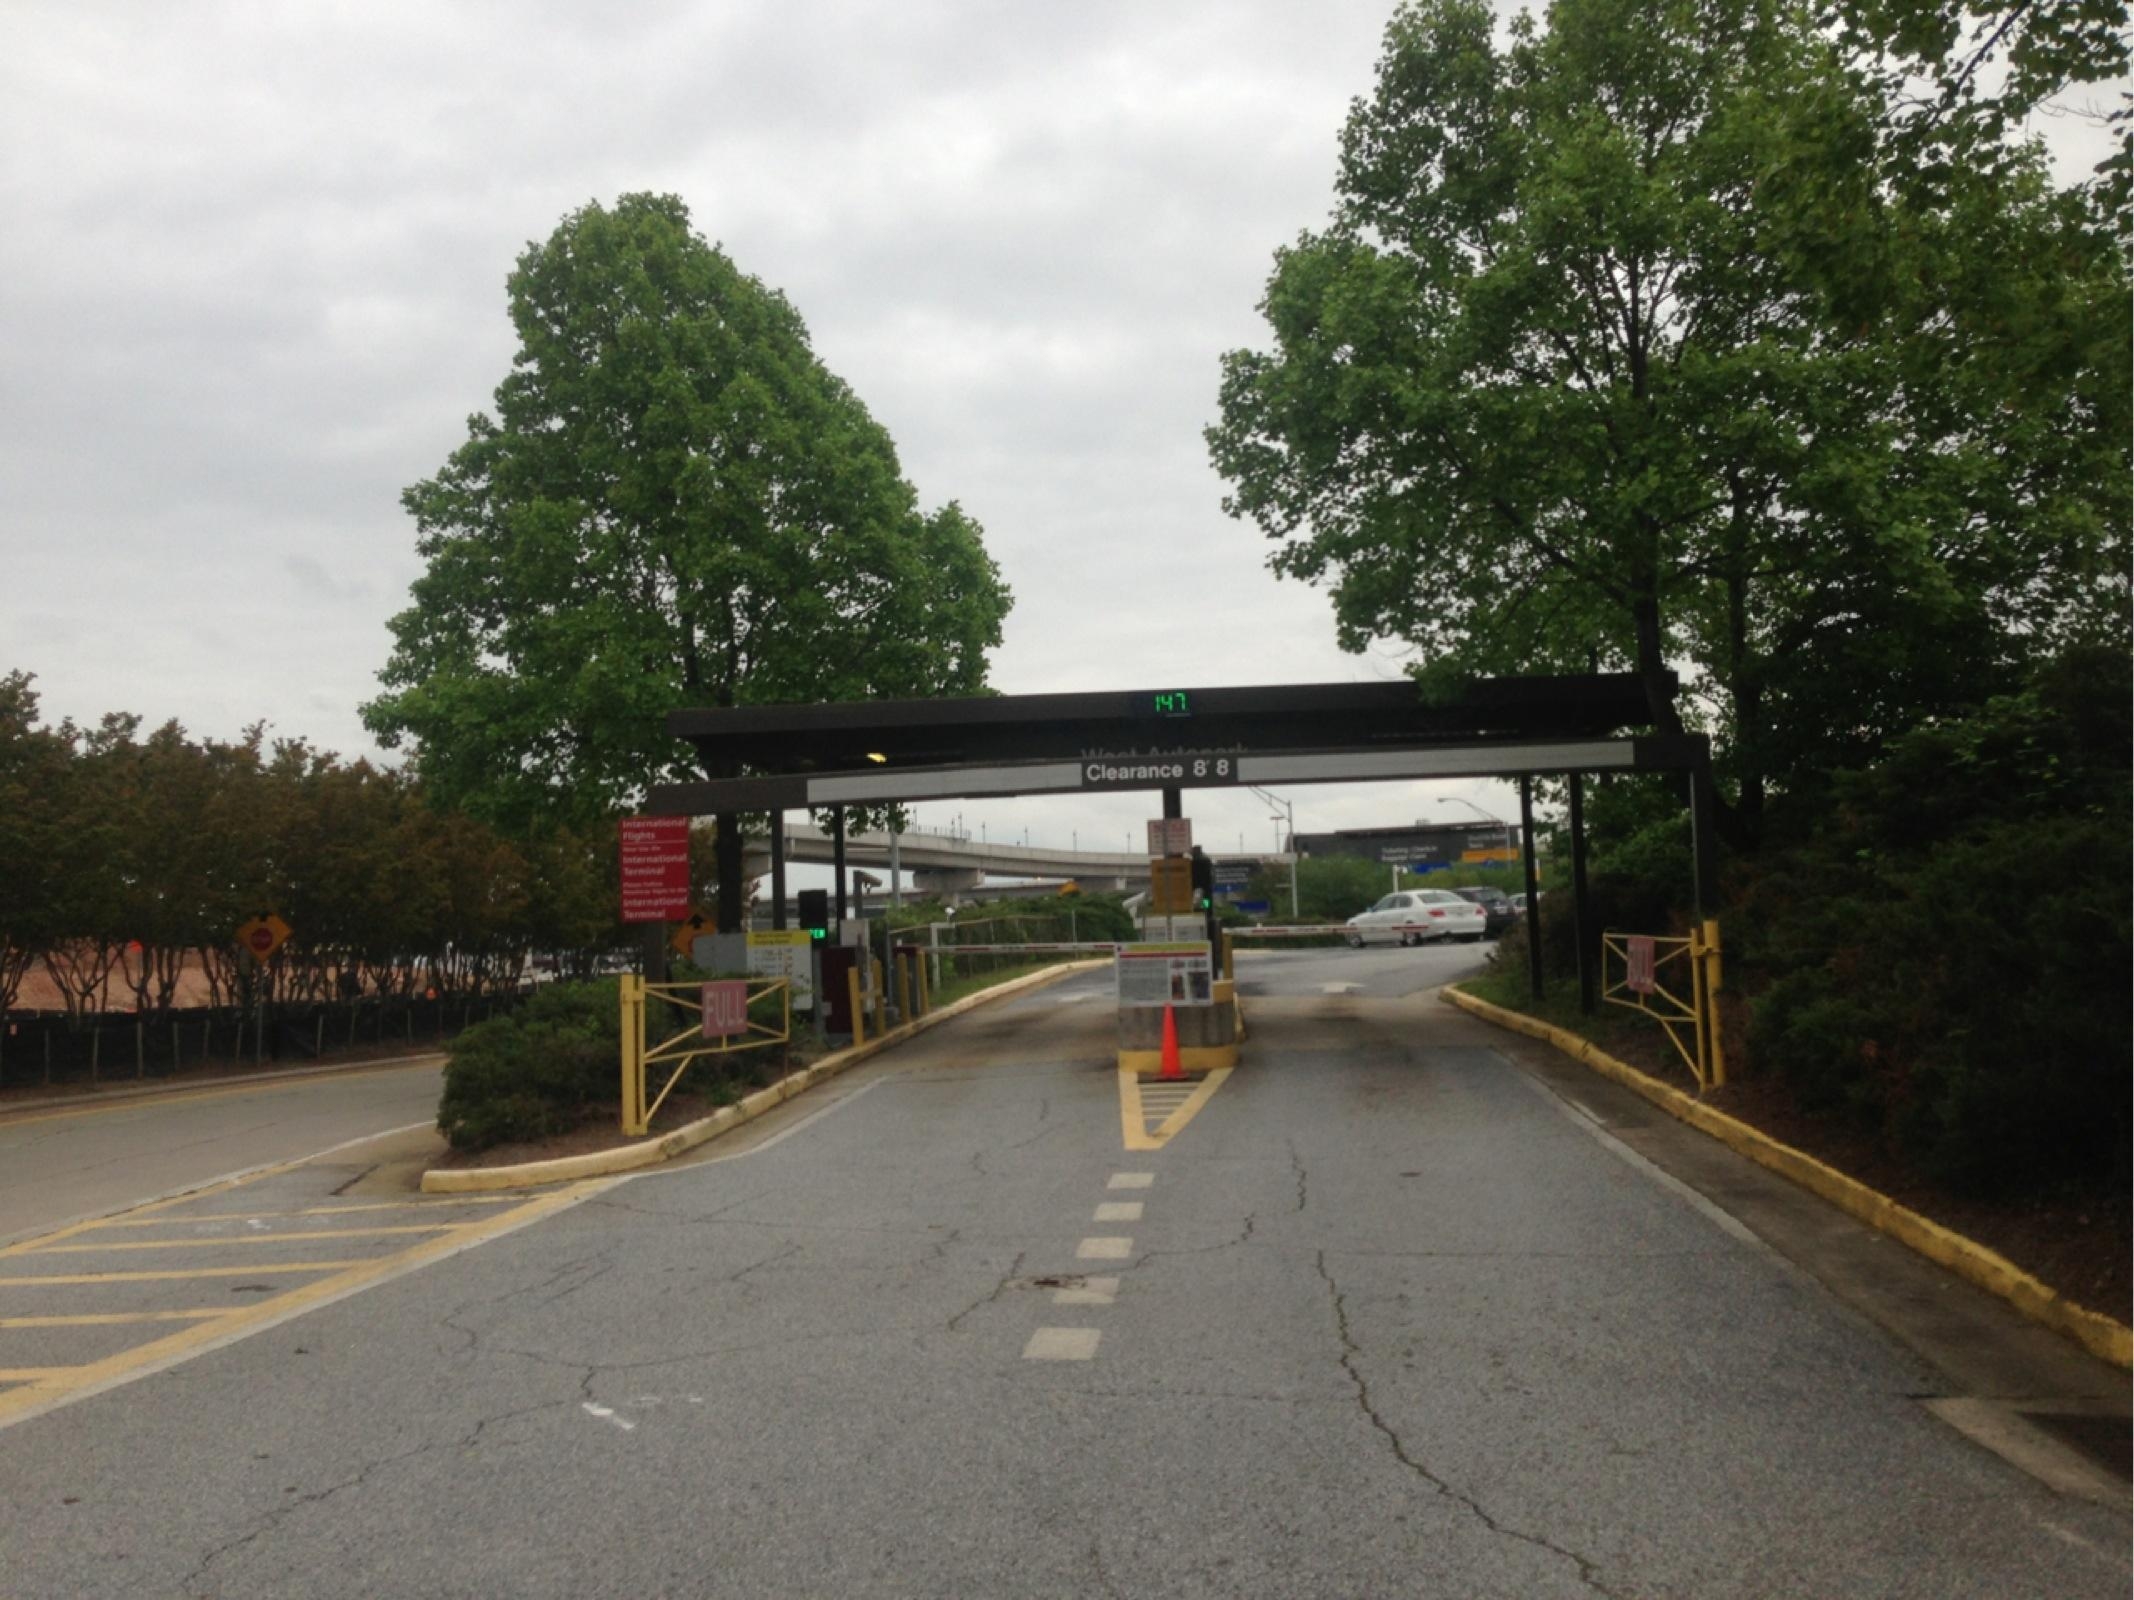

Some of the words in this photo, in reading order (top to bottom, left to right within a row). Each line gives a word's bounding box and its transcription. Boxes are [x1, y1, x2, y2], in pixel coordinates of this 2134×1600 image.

[1155, 692, 1187, 713] 147
[1086, 764, 1184, 781] Clearance
[622, 817, 688, 829] International
[622, 831, 656, 843] Flights
[622, 853, 688, 864] International
[624, 867, 666, 877] Terminal
[622, 897, 689, 908] International
[624, 909, 666, 919] Terminal
[705, 989, 745, 1028] FULL
